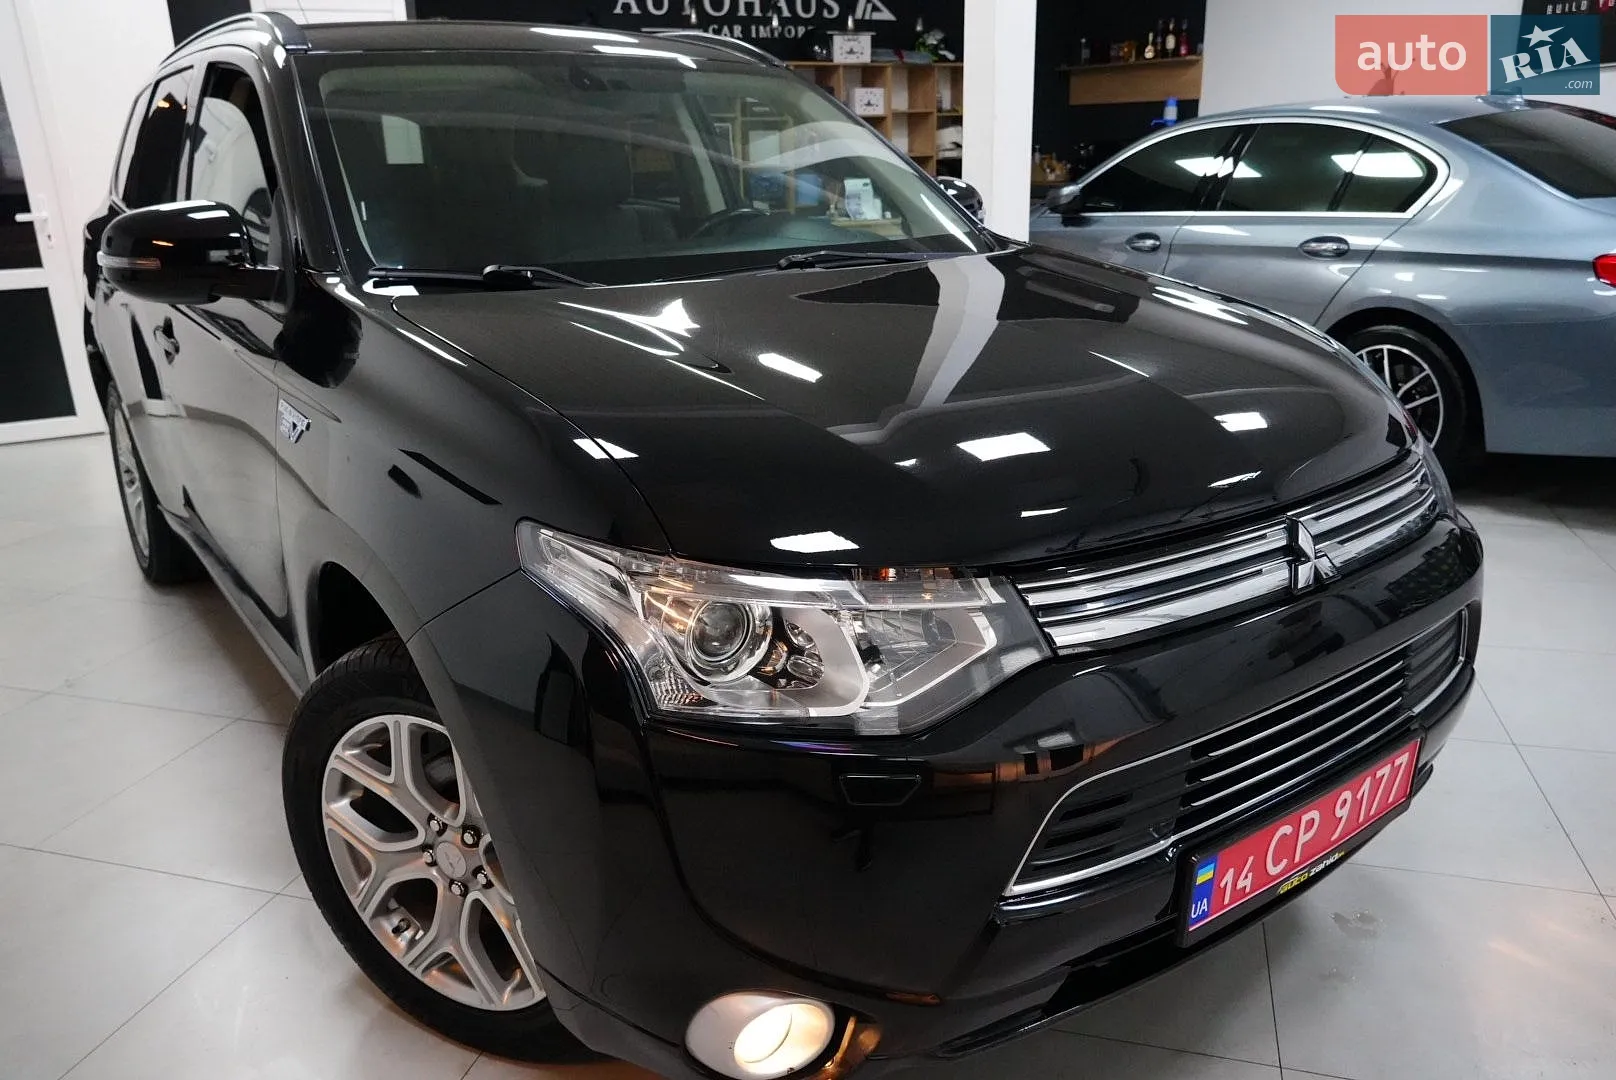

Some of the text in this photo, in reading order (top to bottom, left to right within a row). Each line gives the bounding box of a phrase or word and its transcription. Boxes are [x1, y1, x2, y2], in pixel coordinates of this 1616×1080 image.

[708, 24, 816, 39] CAR IMPOR
[1220, 752, 1410, 906] 14 CP 9177
[1191, 897, 1208, 919] UA
